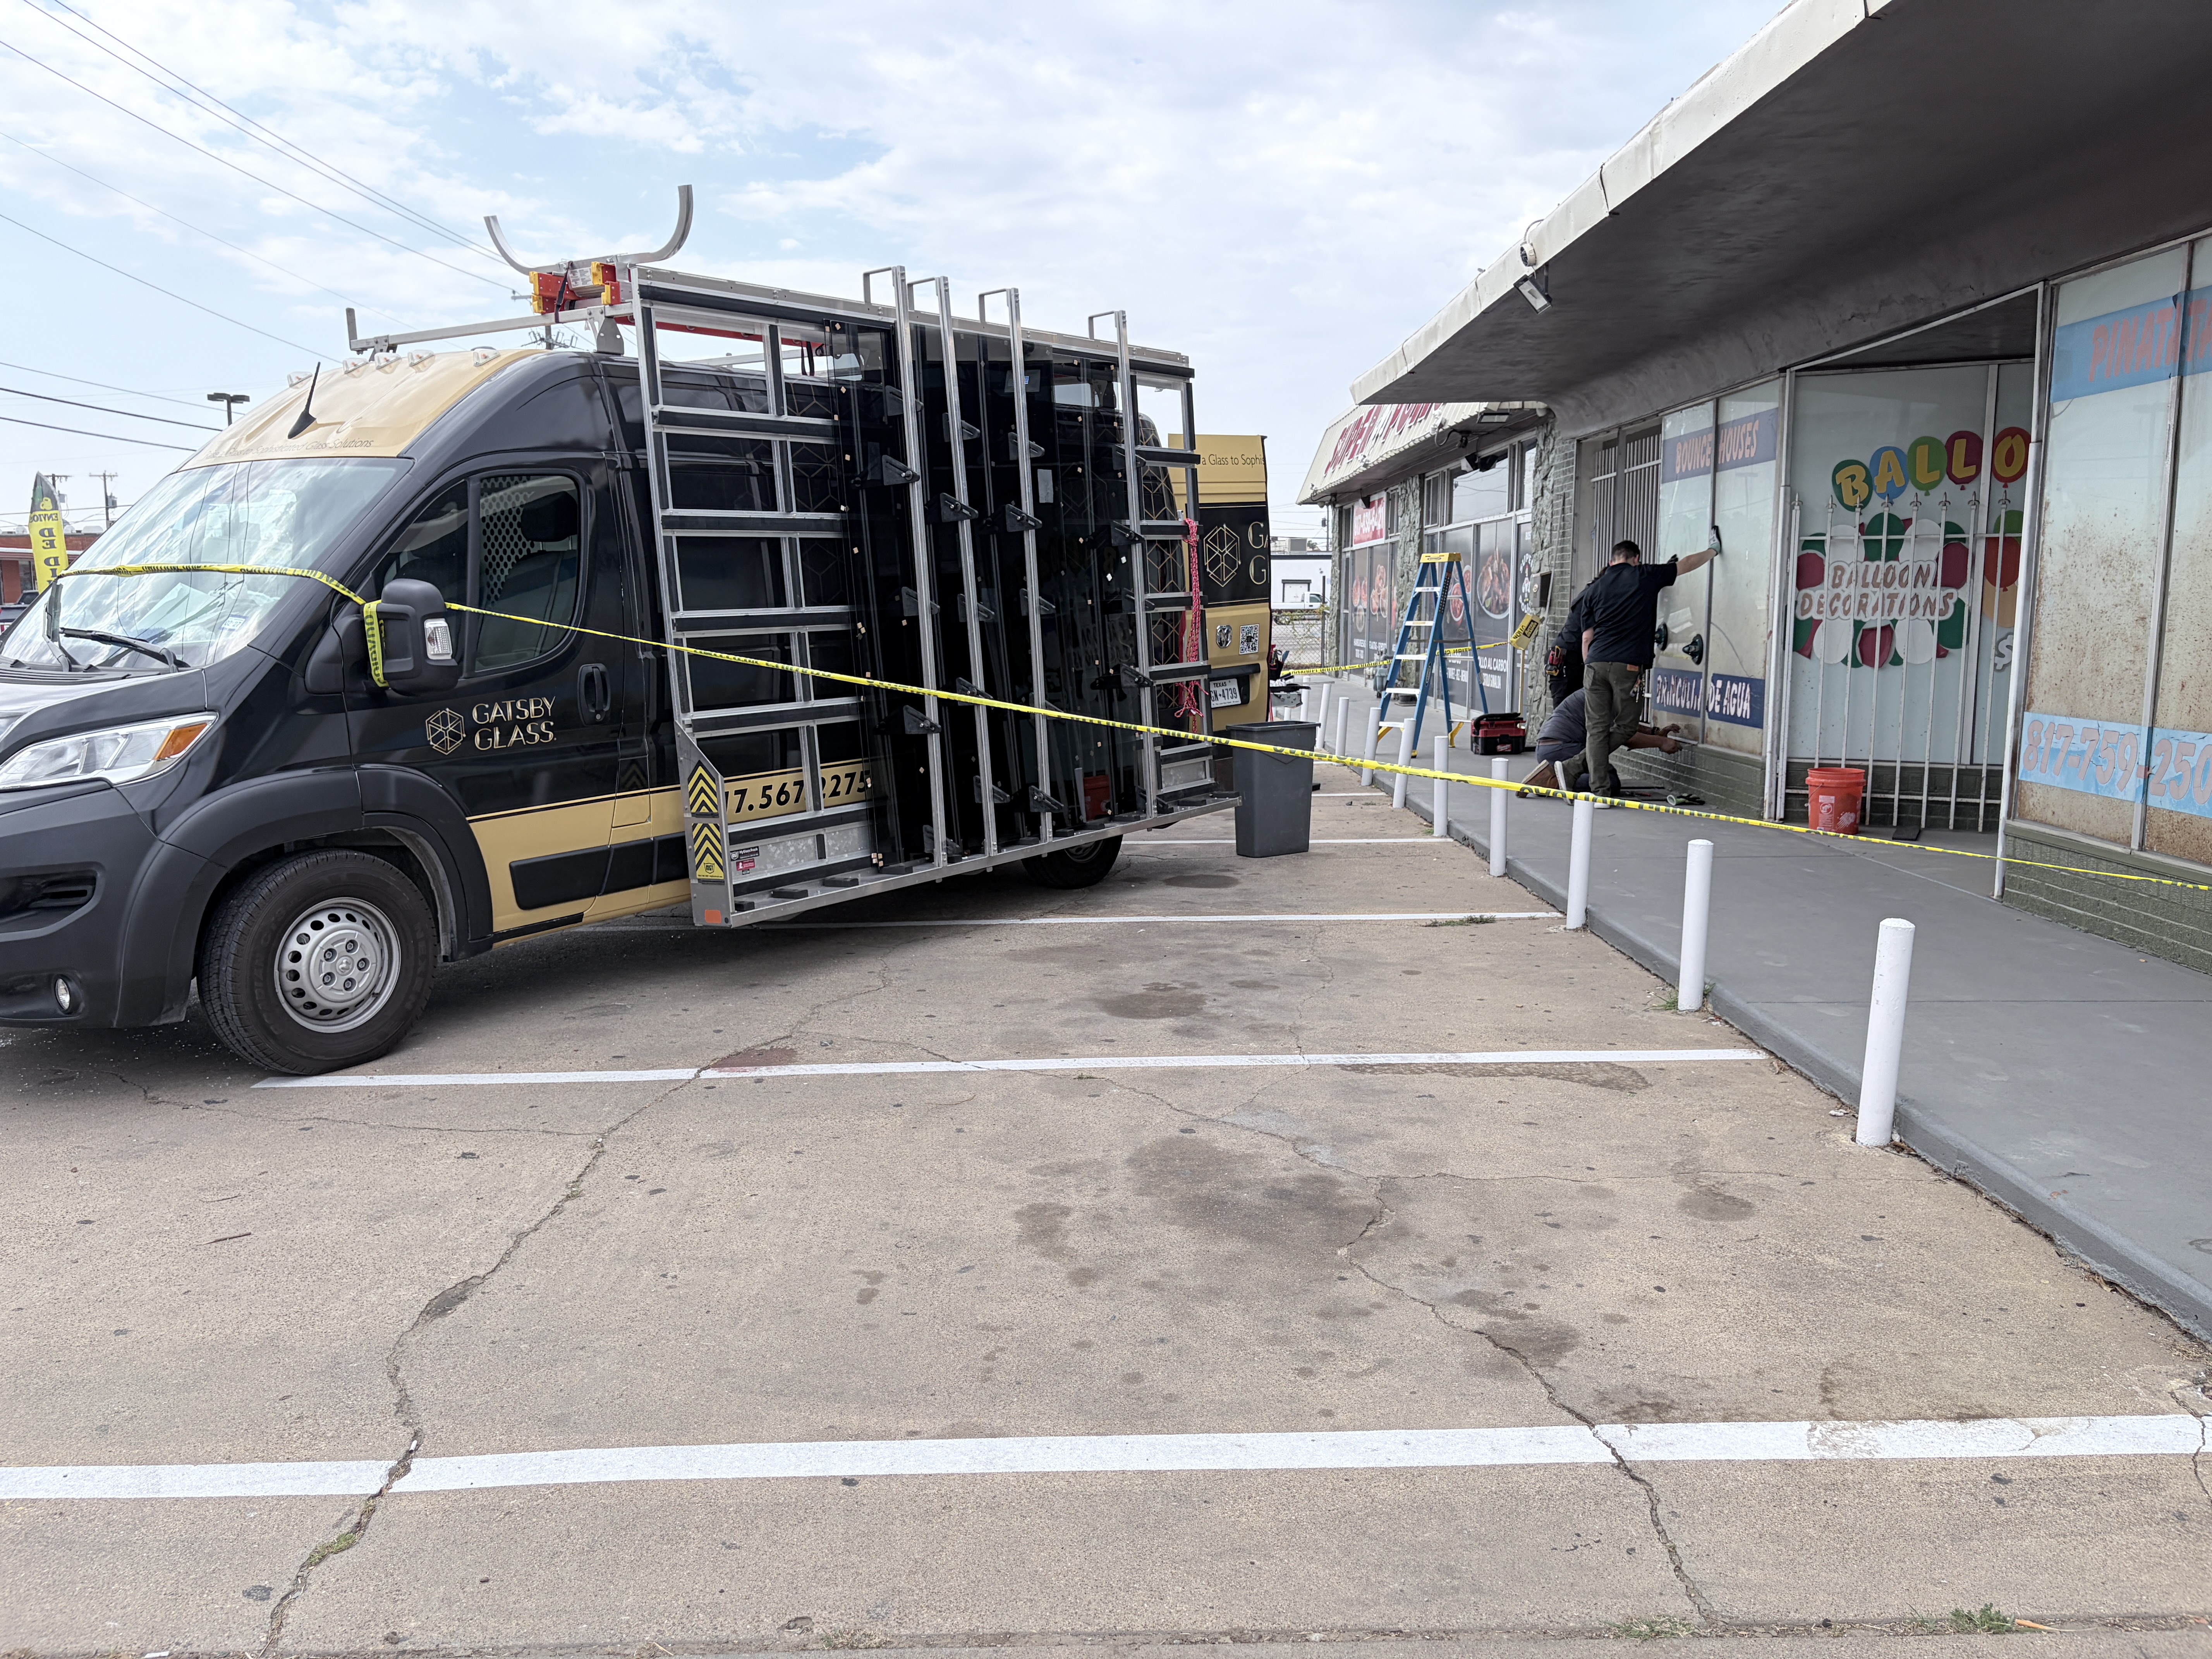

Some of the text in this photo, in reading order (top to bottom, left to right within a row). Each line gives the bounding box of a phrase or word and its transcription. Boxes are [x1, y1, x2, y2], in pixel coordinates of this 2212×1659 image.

[253, 442, 305, 456] Sophisticated
[306, 441, 328, 450] Glass
[329, 438, 374, 448] Solutions
[1676, 419, 1759, 474] BOUNCE HOUSES
[1208, 454, 1229, 465] Glass
[1230, 456, 1239, 465] to
[1832, 564, 1930, 589] BALLOON
[1800, 592, 1953, 618] DECORATIONS
[1478, 656, 1487, 668] OLLO
[1492, 658, 1508, 673] CARBO
[472, 696, 556, 724] GATSBY
[1708, 679, 1722, 713] DE
[1723, 680, 1750, 719] AGUA
